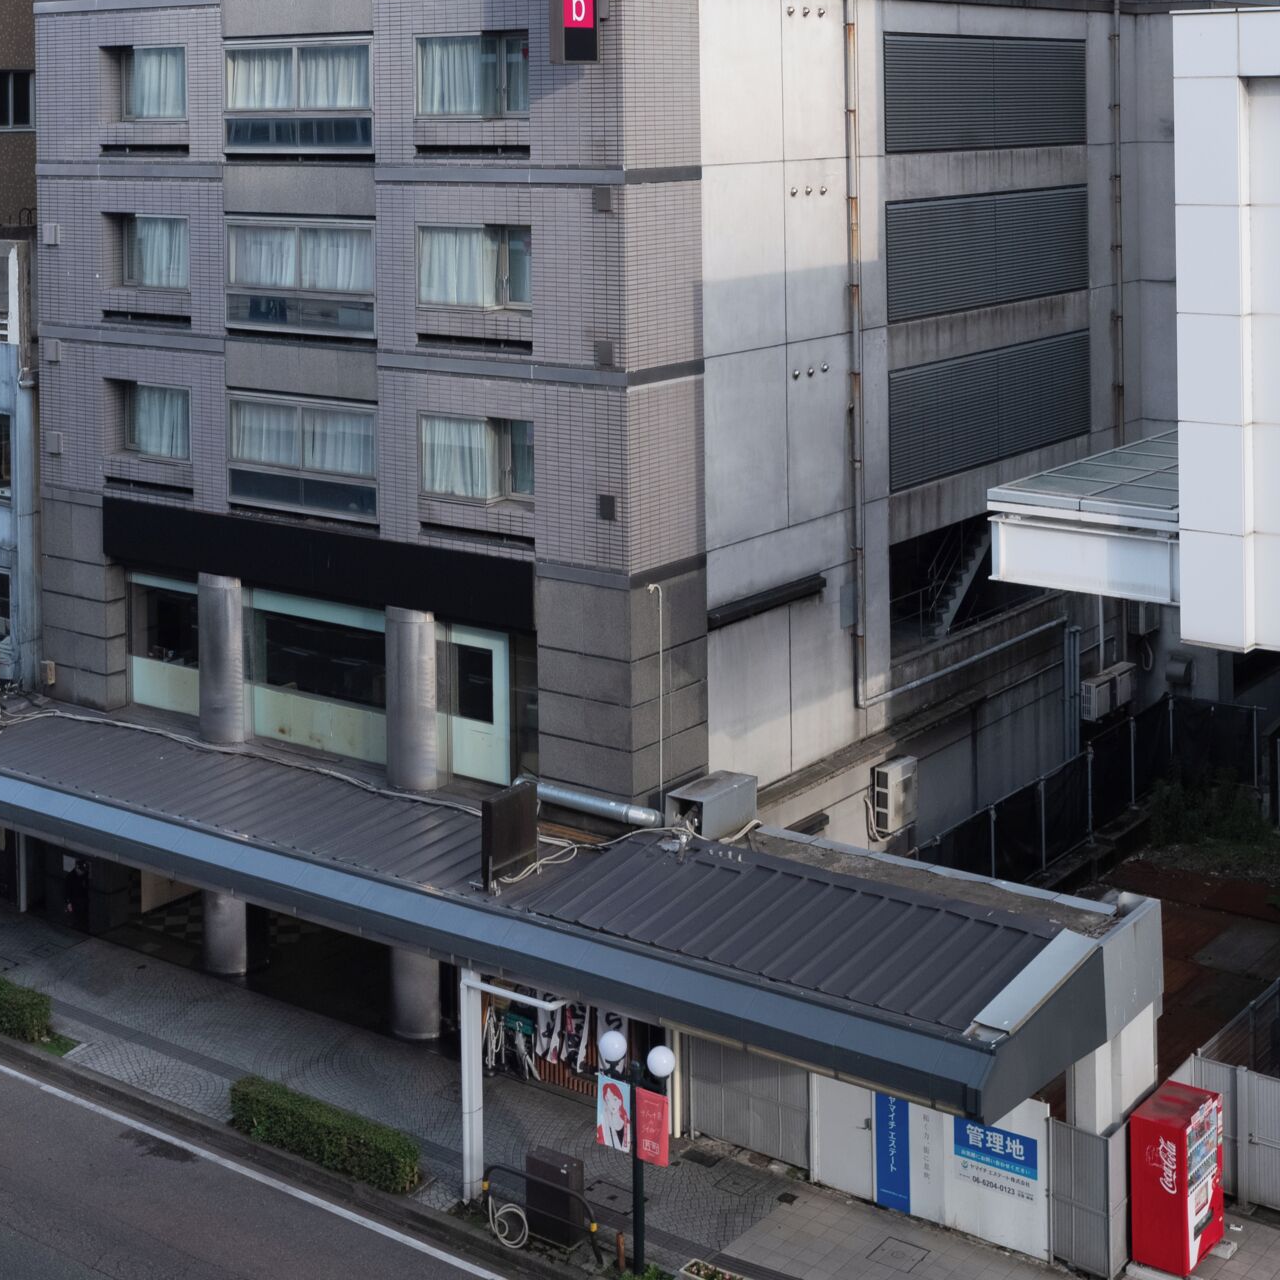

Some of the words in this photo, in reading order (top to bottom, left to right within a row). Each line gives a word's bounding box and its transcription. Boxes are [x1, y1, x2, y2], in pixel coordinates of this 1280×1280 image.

[966, 1123, 1025, 1161] 管理地
[972, 1175, 1016, 1195] 06-6204-0123
